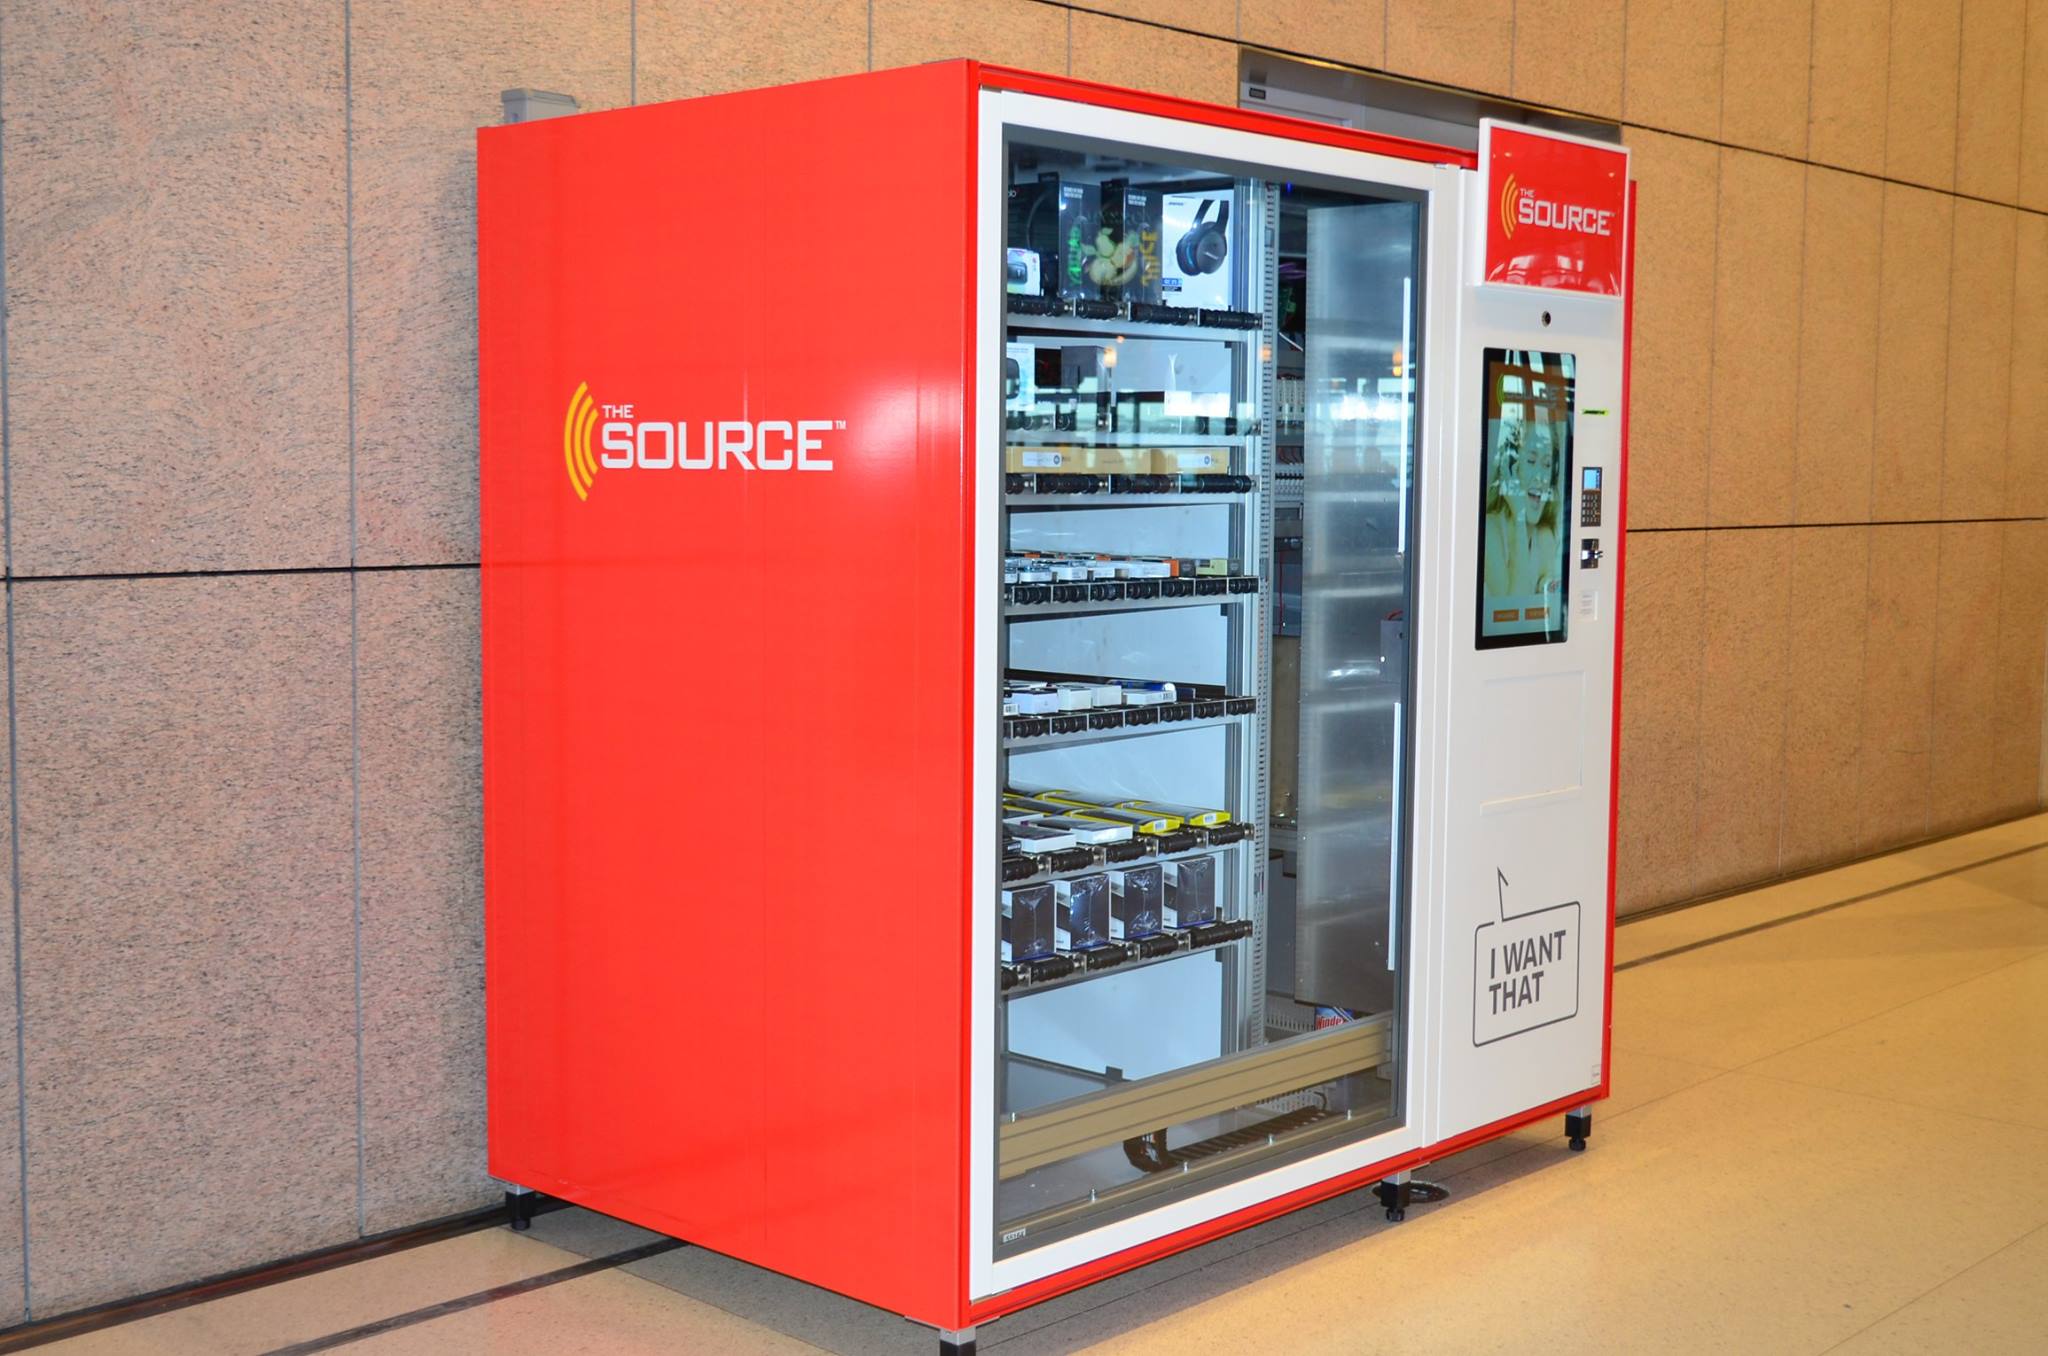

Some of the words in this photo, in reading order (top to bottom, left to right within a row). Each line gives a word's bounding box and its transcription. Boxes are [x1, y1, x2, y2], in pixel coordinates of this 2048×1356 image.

[1519, 188, 1535, 198] THE
[1518, 197, 1611, 236] SOURCE
[601, 404, 634, 418] THE
[601, 420, 833, 470] SOURCE
[1490, 948, 1496, 979] I
[1503, 929, 1567, 975] WANT
[1488, 970, 1545, 1015] THAT
[1315, 1014, 1347, 1031] Winde
